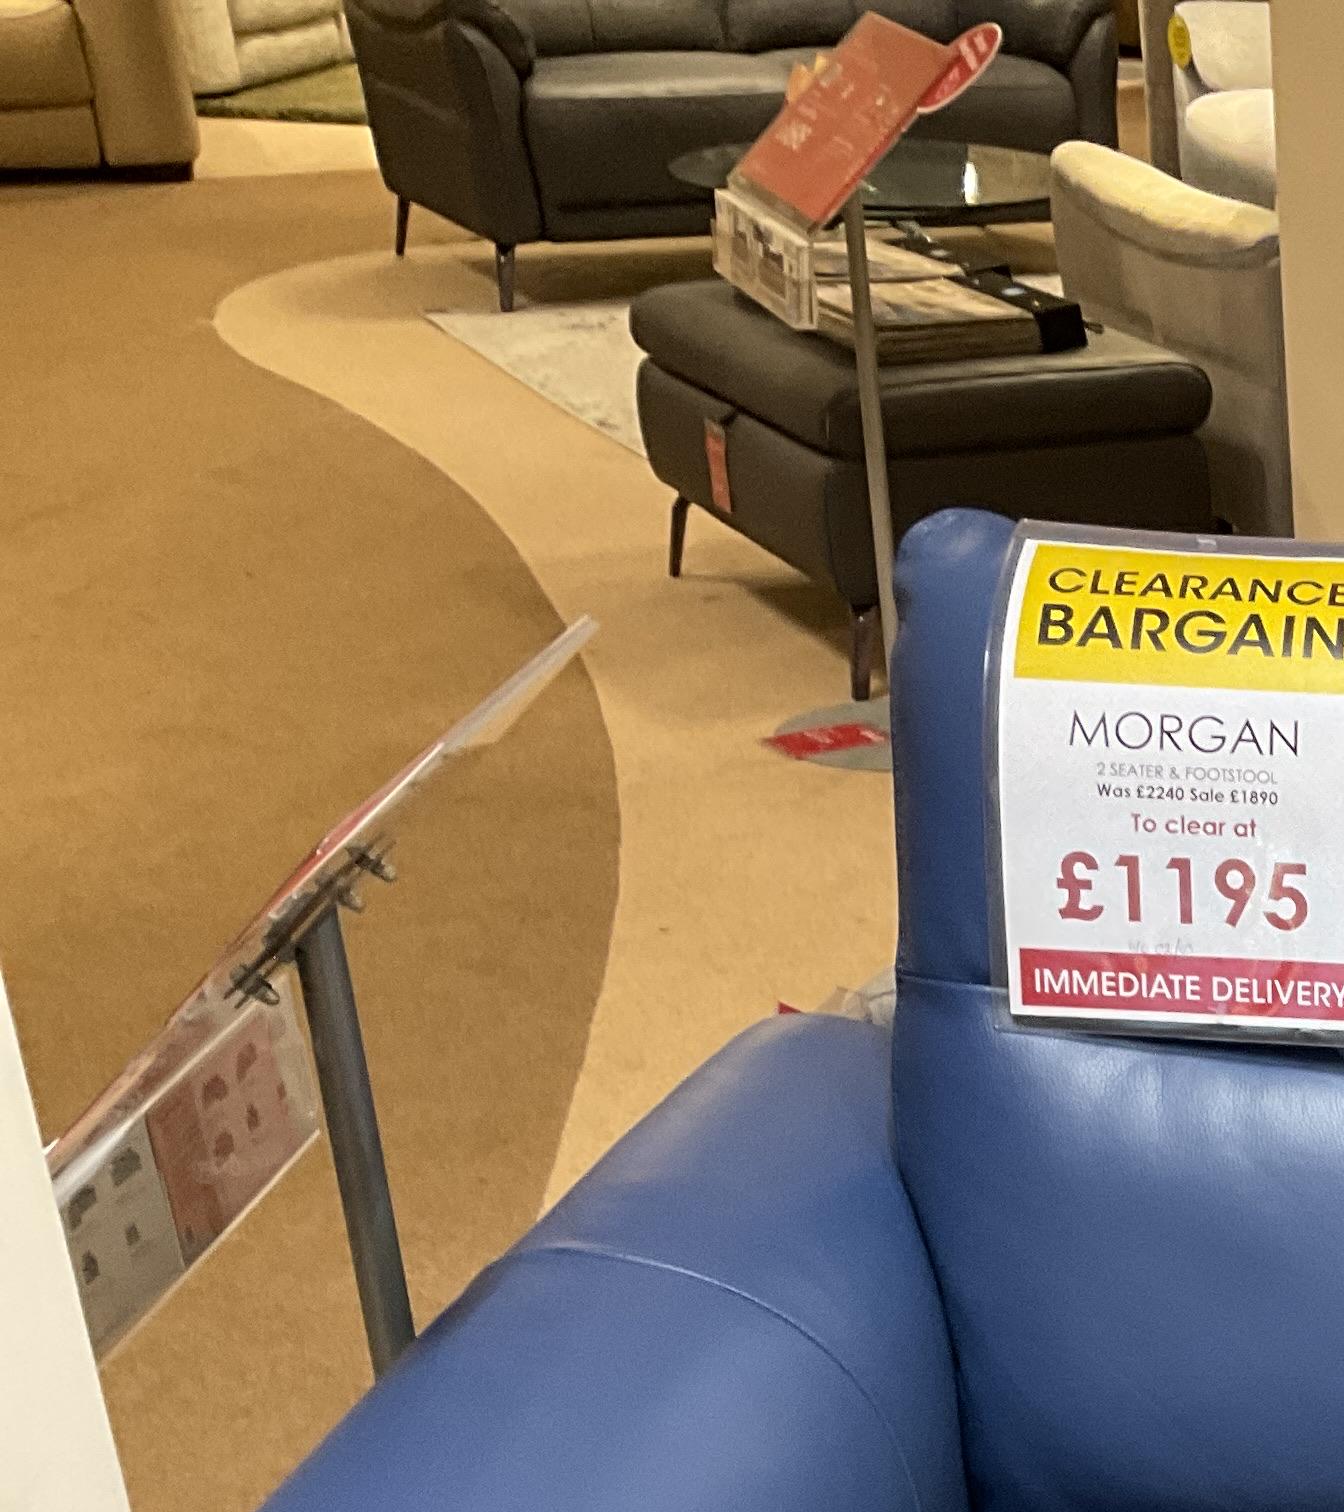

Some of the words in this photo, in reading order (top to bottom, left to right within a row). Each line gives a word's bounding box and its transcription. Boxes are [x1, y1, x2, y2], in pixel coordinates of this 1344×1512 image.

[1069, 711, 1300, 757] MORGAN
[1096, 762, 1106, 776] 2
[1110, 763, 1164, 779] SEATER
[1168, 766, 1180, 780] &
[1185, 766, 1278, 785] FOOTSTOOL
[1097, 783, 1131, 798] Was
[1137, 785, 1185, 801] £2240
[1190, 787, 1225, 804] Sale
[1230, 789, 1279, 806] £1890
[1131, 813, 1157, 833] To
[1165, 815, 1226, 836] clear
[1234, 818, 1257, 838] at
[1056, 850, 1308, 931] £1195
[1033, 967, 1201, 1002] IMMEDIATE
